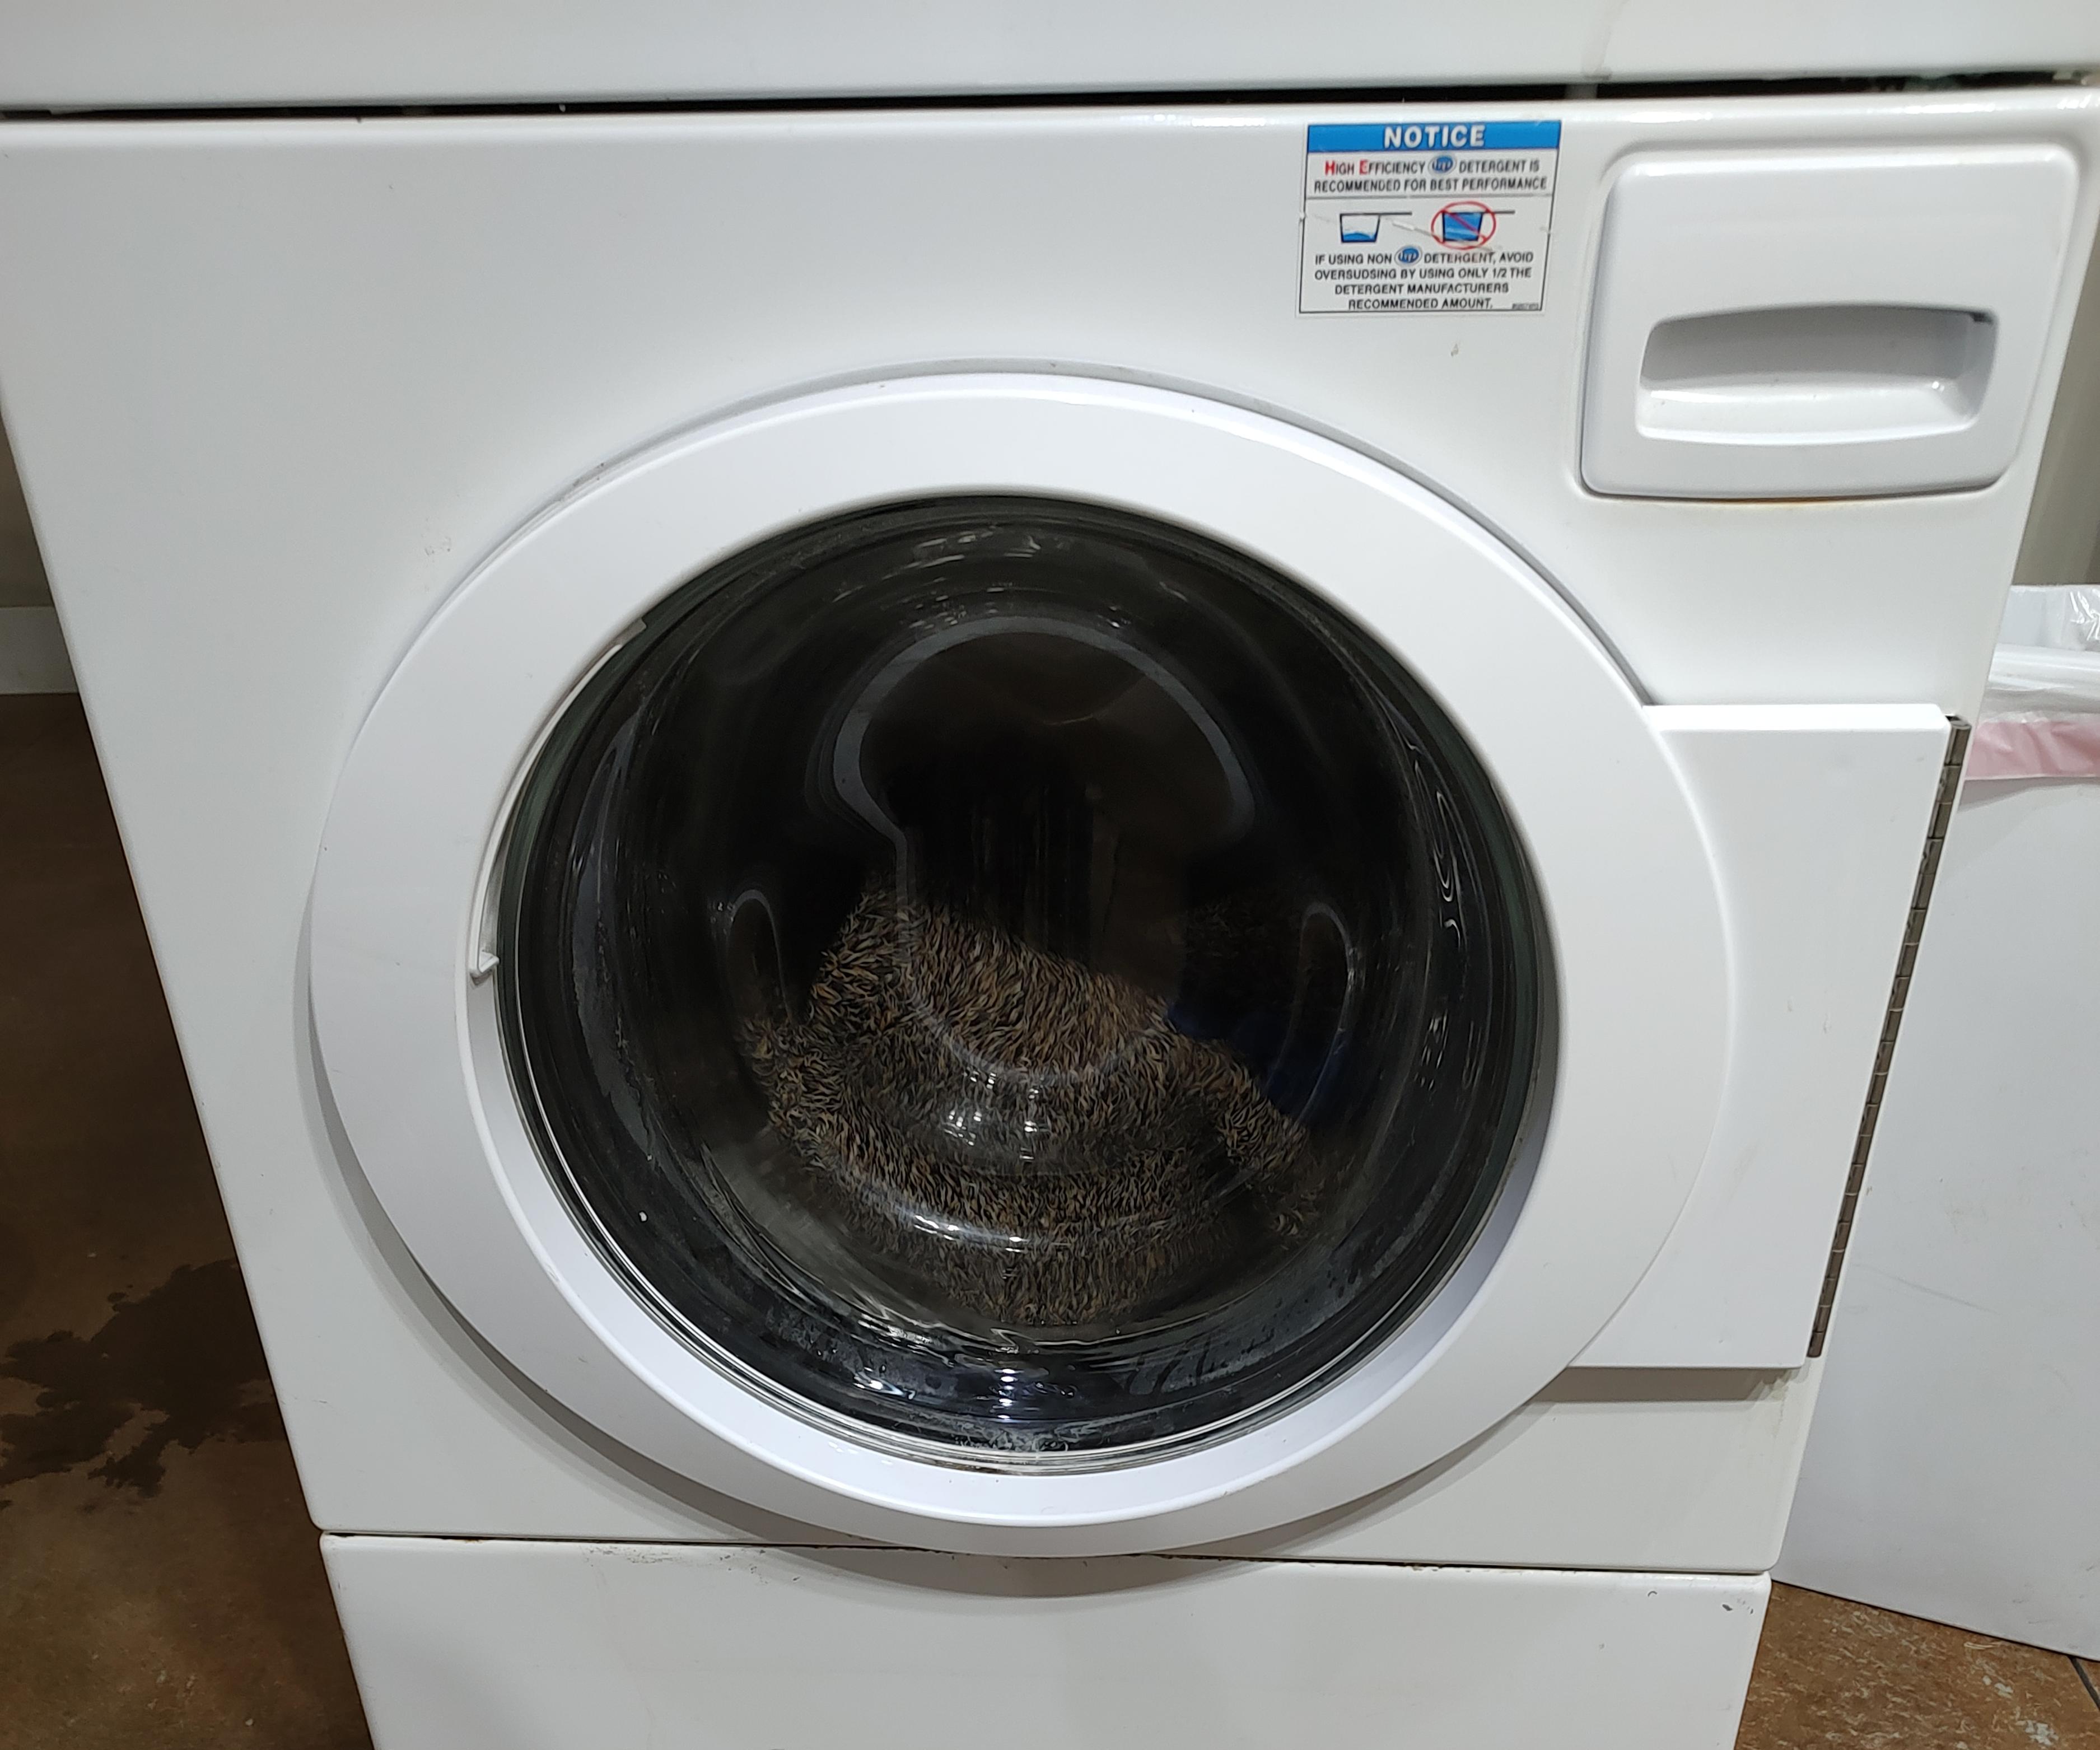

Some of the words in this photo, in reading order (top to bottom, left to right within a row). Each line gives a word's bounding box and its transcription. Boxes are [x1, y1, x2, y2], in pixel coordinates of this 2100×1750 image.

[1384, 125, 1486, 148] NOTICE
[1324, 160, 1355, 175] HIGH
[1359, 159, 1425, 175] EFFICIENCY
[1459, 160, 1528, 174] DETERGENT
[1530, 159, 1539, 171] IS
[1314, 179, 1401, 193] RECOMMENDED
[1404, 180, 1426, 192] FOR
[1430, 179, 1458, 192] BEST
[1462, 176, 1547, 191] PERFORMANCE
[1315, 255, 1325, 265] IF
[1328, 254, 1363, 265] USING
[1367, 254, 1392, 264] NON
[1424, 253, 1496, 264] DETERGENT,
[1499, 253, 1534, 263] AVOID
[1314, 269, 1397, 280] OVERSUDSING
[1400, 269, 1416, 279] BY
[1419, 268, 1455, 279] USING
[1458, 268, 1488, 278] ONLY
[1492, 268, 1506, 278] 1/2
[1510, 267, 1532, 278] THE
[1334, 284, 1404, 295] DETERGENT
[1407, 283, 1509, 295] MANUFACTURERS
[1348, 299, 1438, 310] RECOMMENDED
